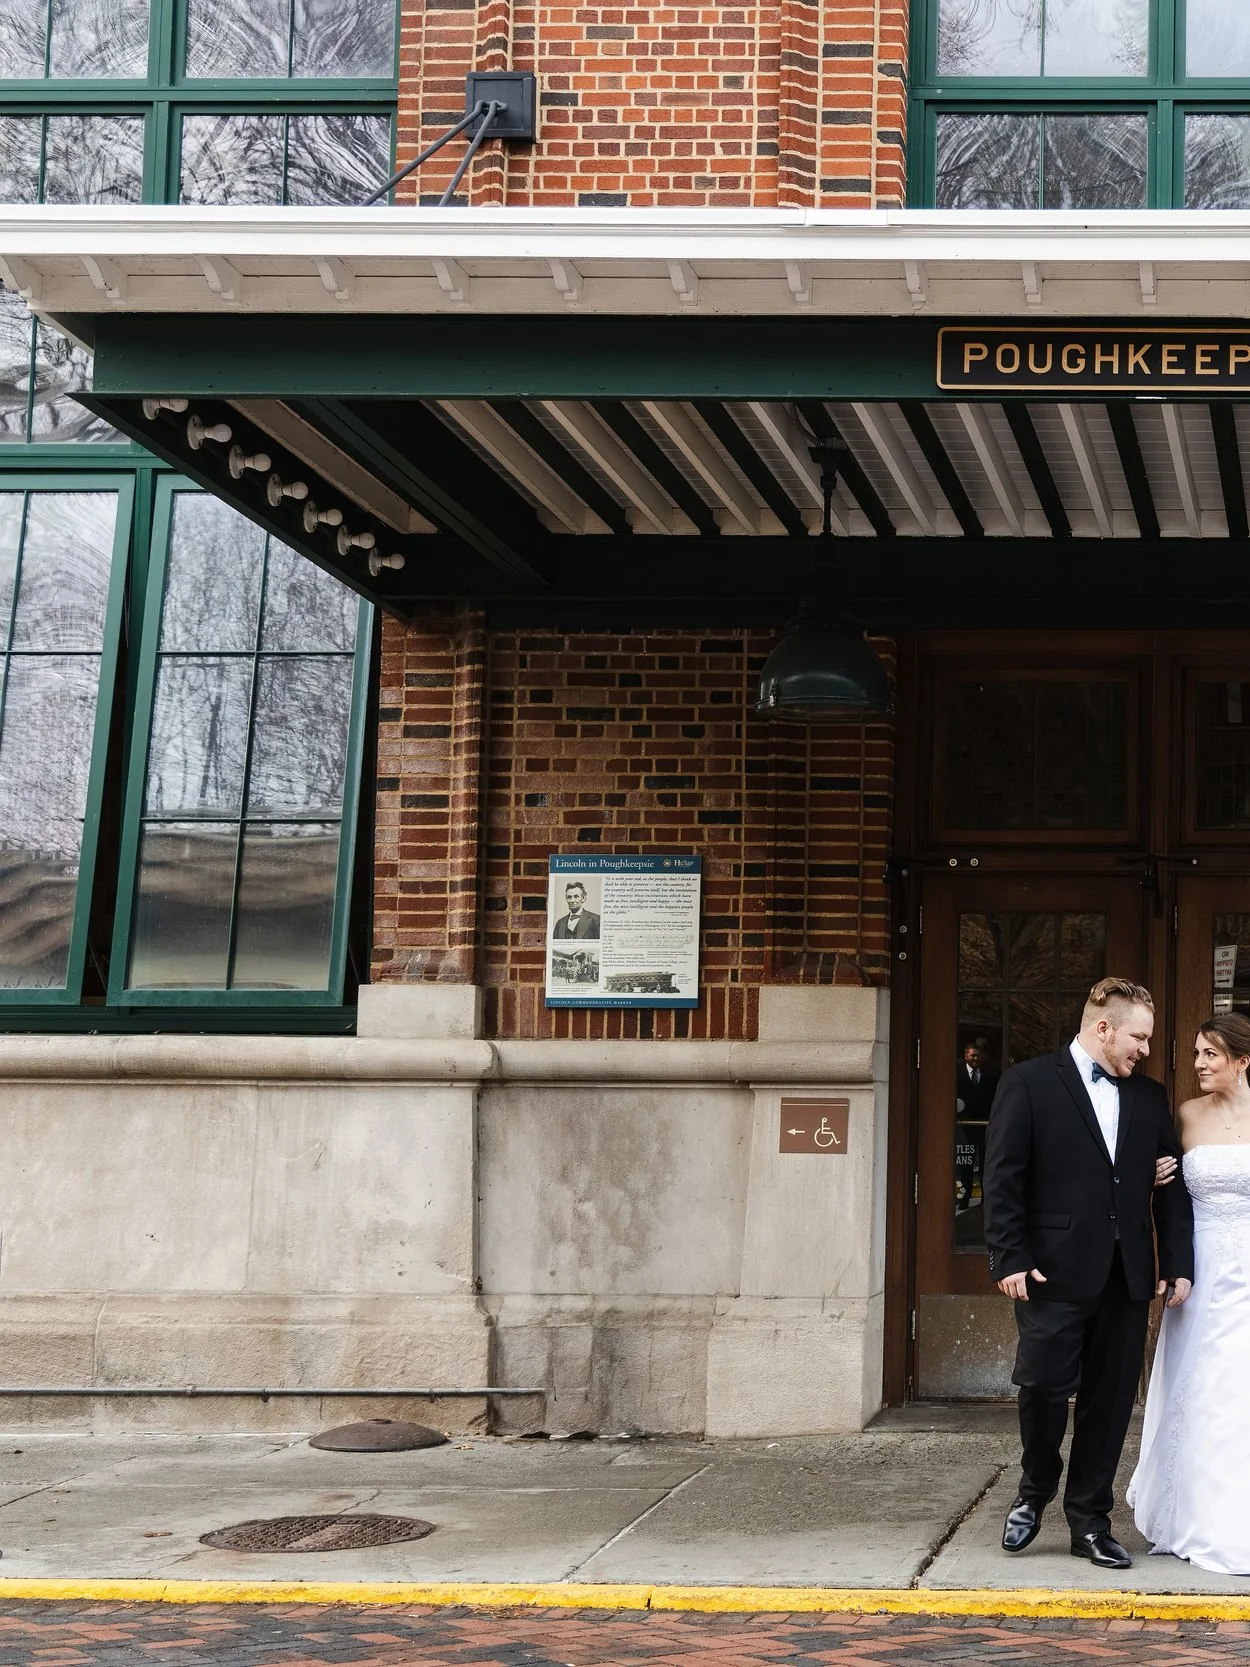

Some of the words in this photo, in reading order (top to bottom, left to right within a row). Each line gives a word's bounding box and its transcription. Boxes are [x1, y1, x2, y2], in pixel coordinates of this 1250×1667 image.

[556, 859, 586, 868] Lincoln
[589, 859, 597, 868] in
[600, 859, 655, 871] Poughkeepsie
